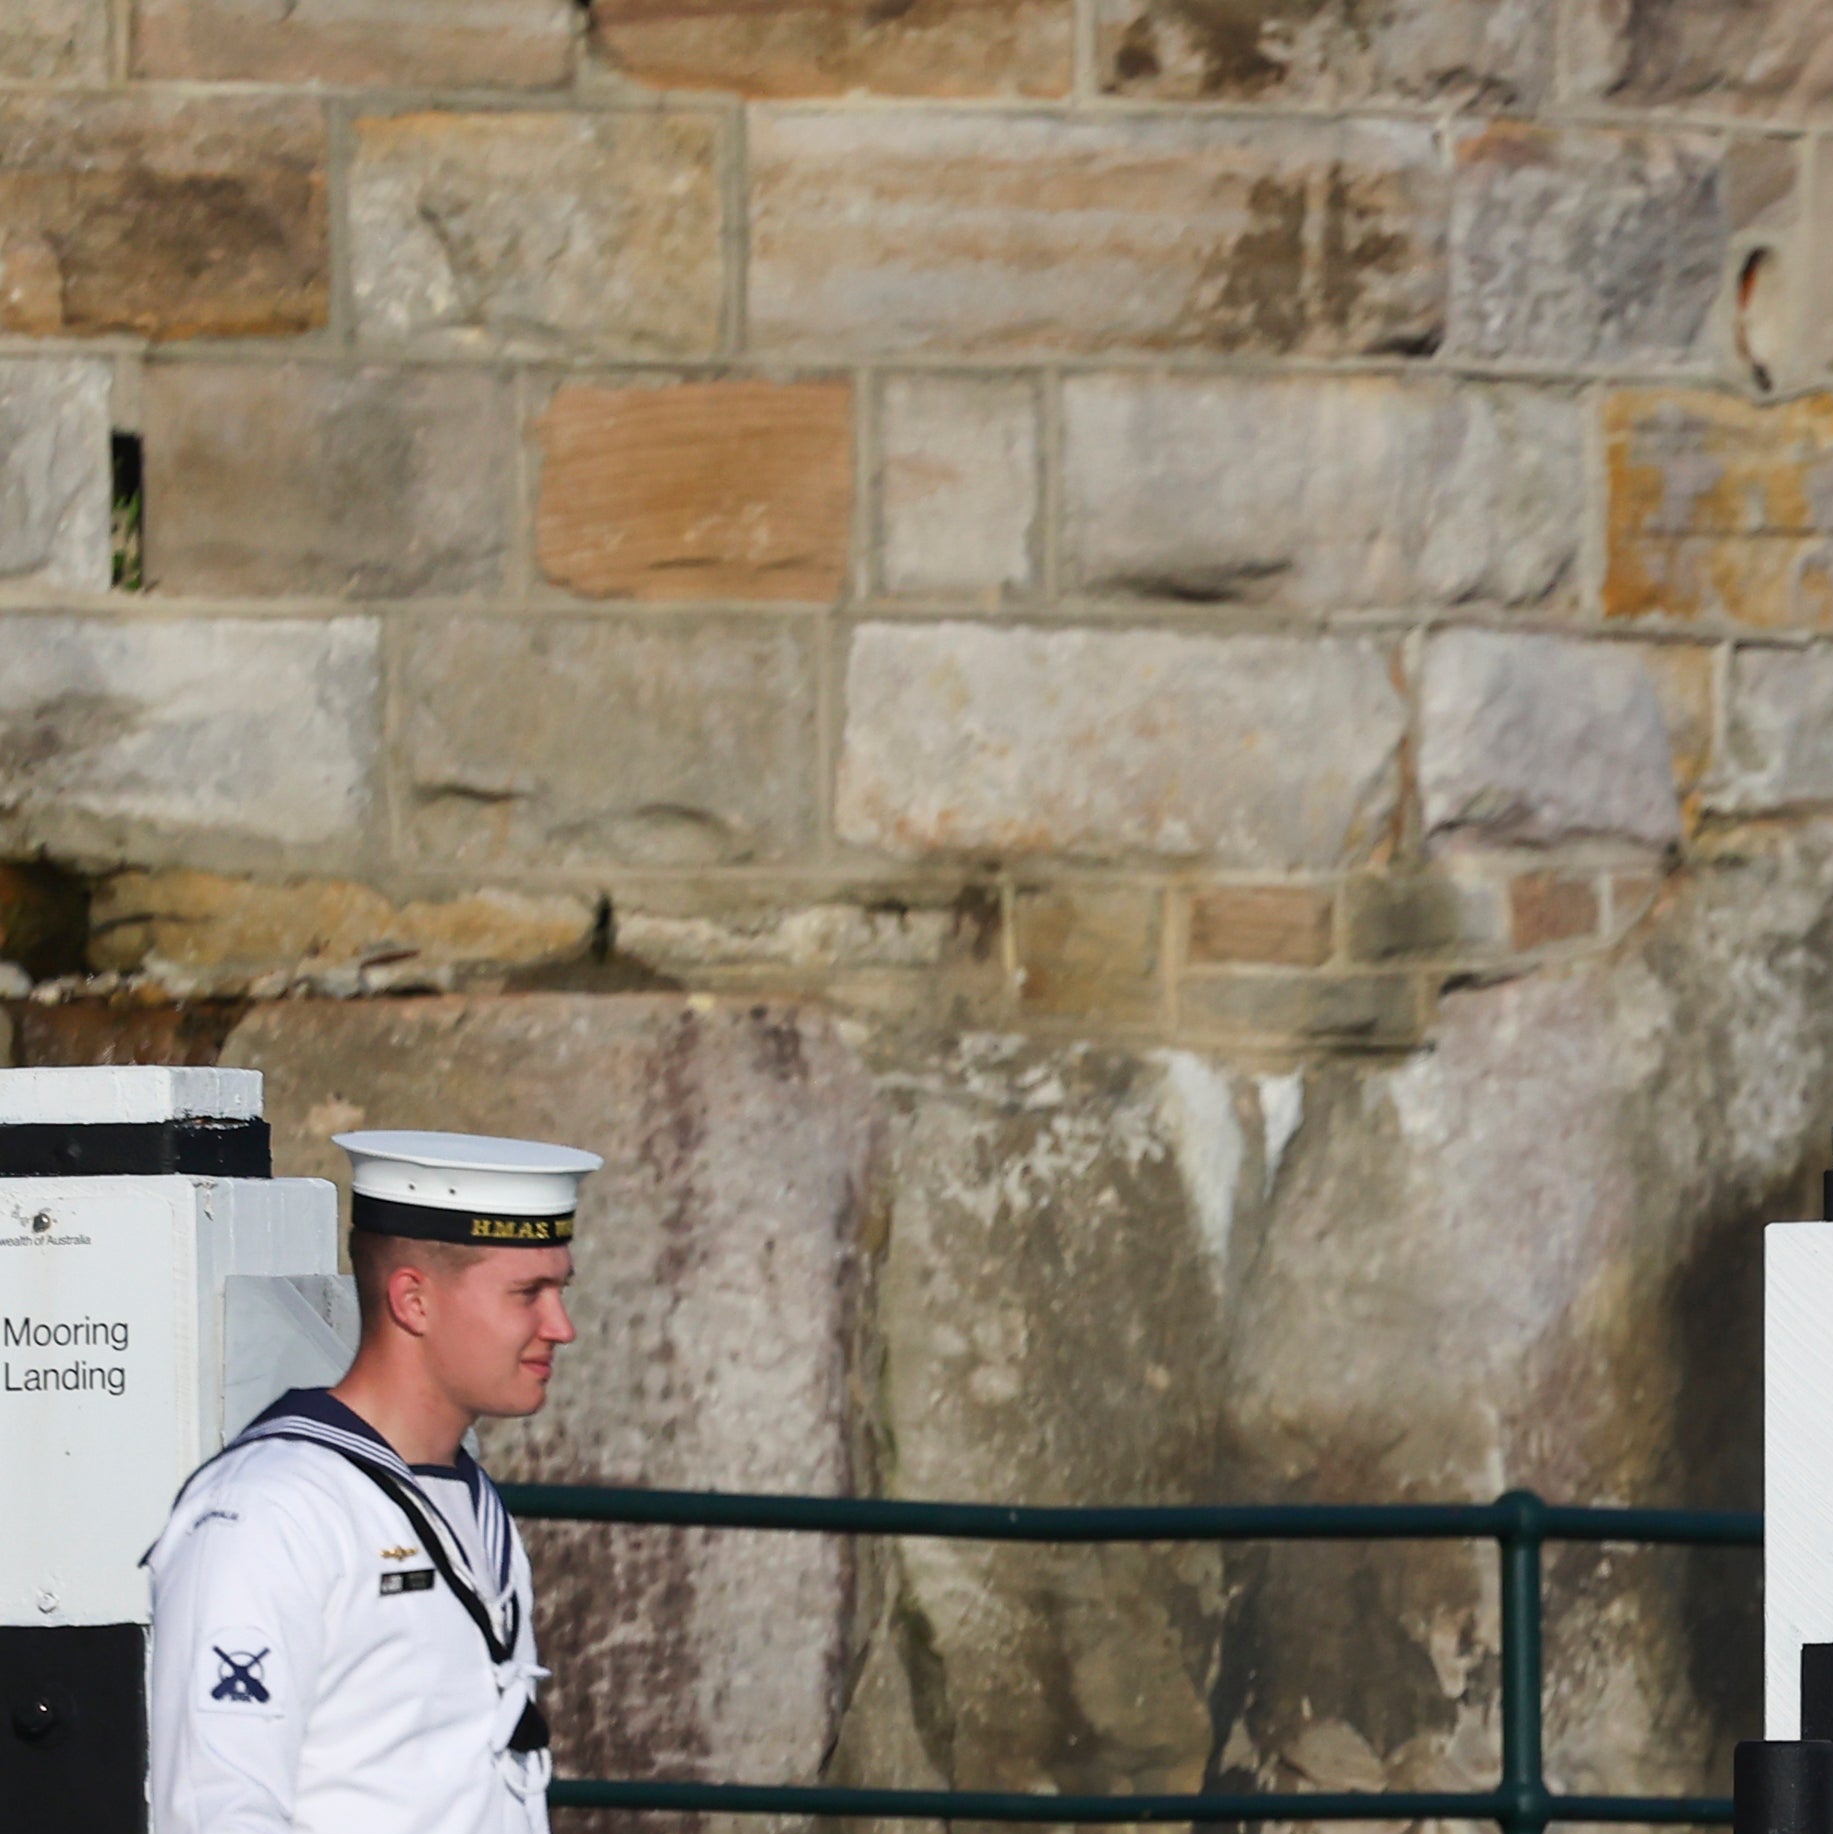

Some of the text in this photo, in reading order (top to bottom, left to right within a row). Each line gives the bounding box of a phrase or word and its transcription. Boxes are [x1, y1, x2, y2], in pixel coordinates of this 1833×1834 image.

[47, 1234, 92, 1246] Australia
[4, 1315, 129, 1352] Mooring
[4, 1360, 126, 1396] Landing
